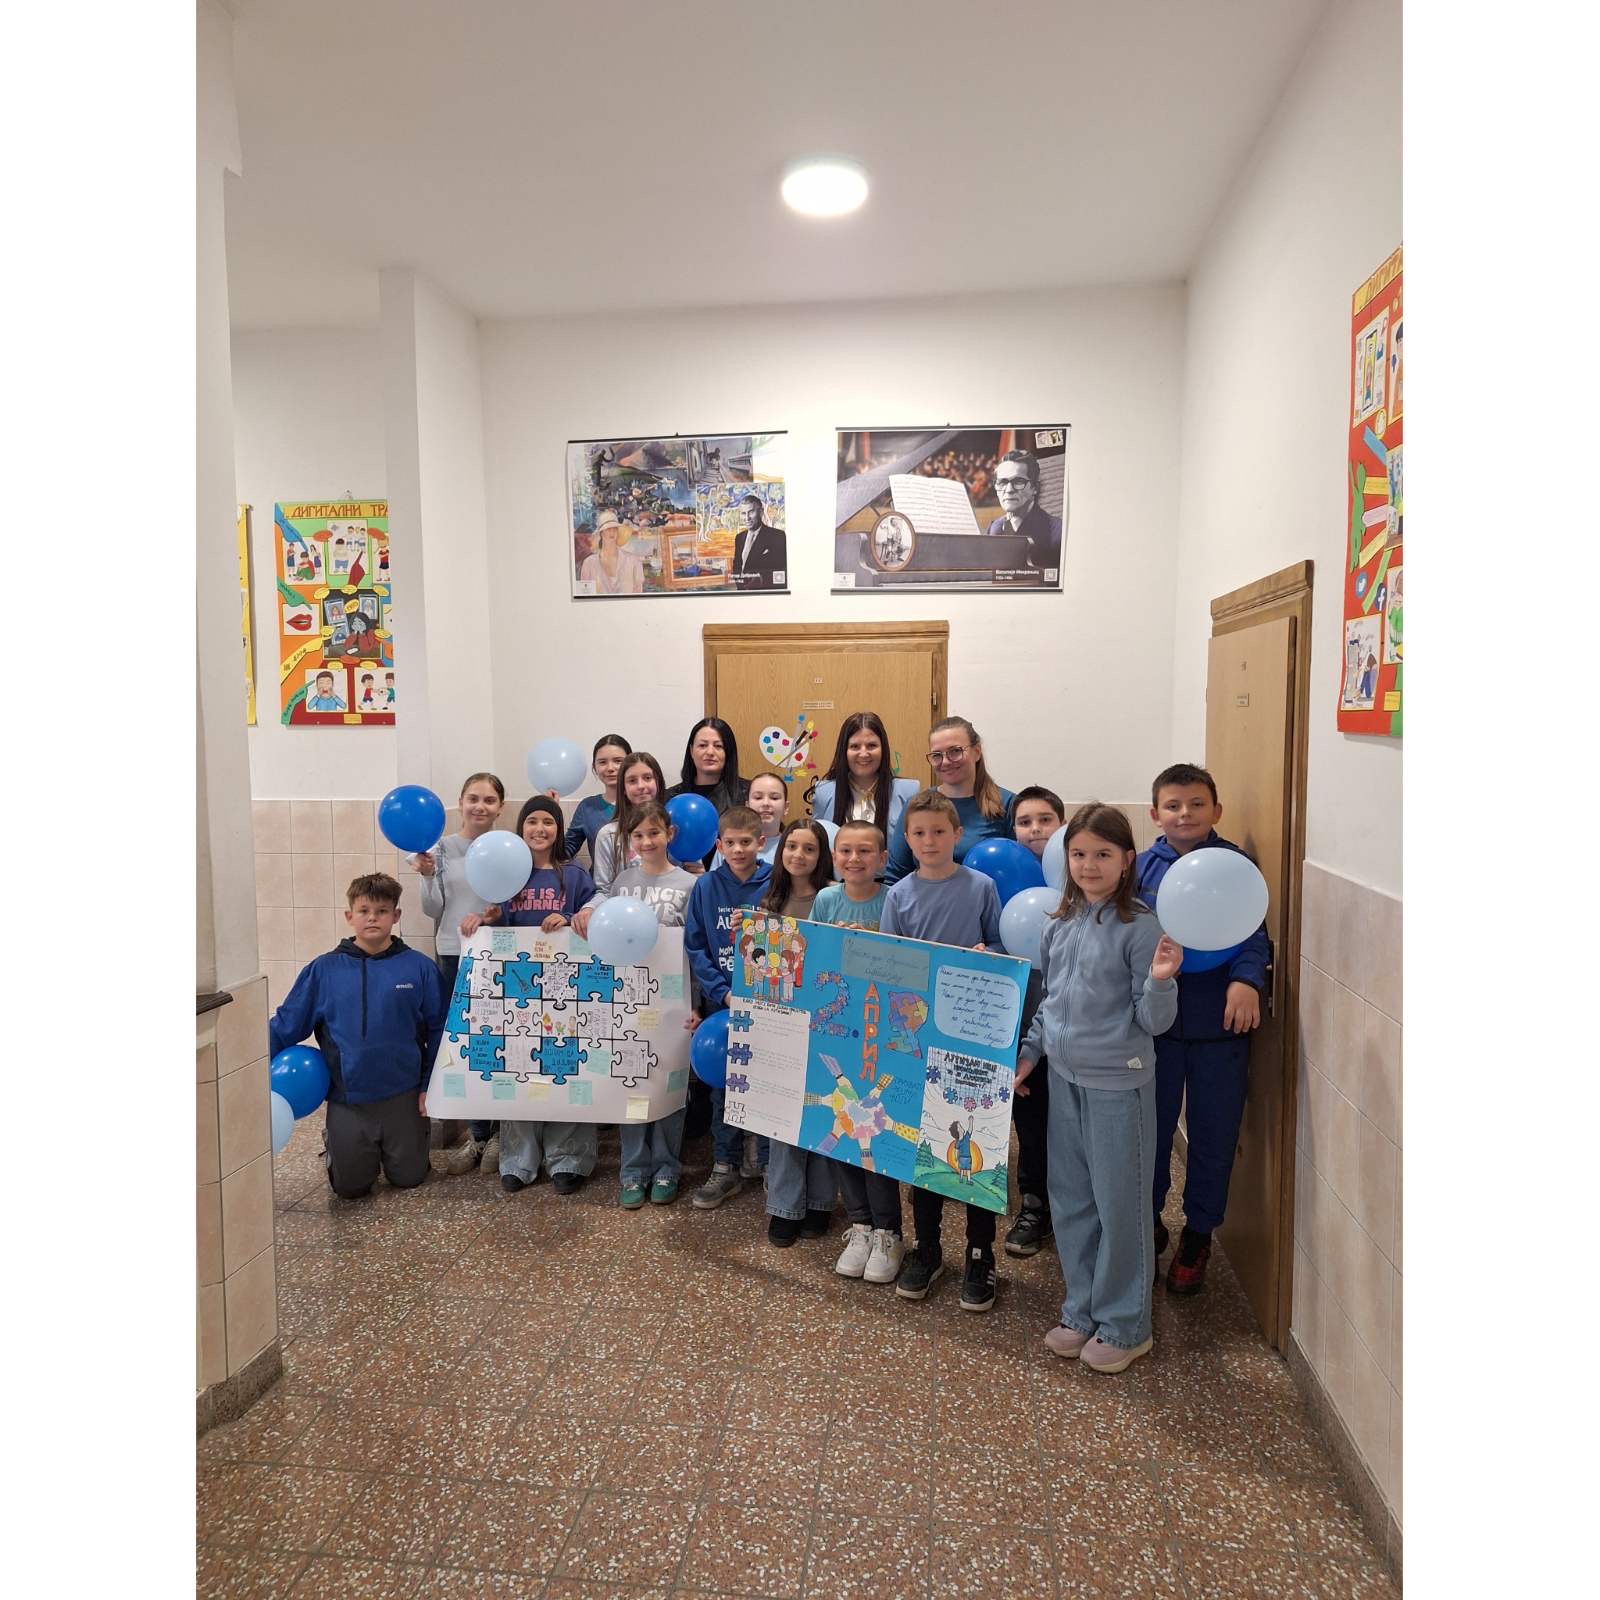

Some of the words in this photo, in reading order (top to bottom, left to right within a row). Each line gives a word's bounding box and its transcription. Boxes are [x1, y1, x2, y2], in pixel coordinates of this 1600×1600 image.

[292, 504, 362, 518] ДИГИТАЛНИ
[539, 887, 556, 900] IS
[509, 899, 567, 912] JOURNEY
[859, 981, 880, 1083] АПРИЛ
